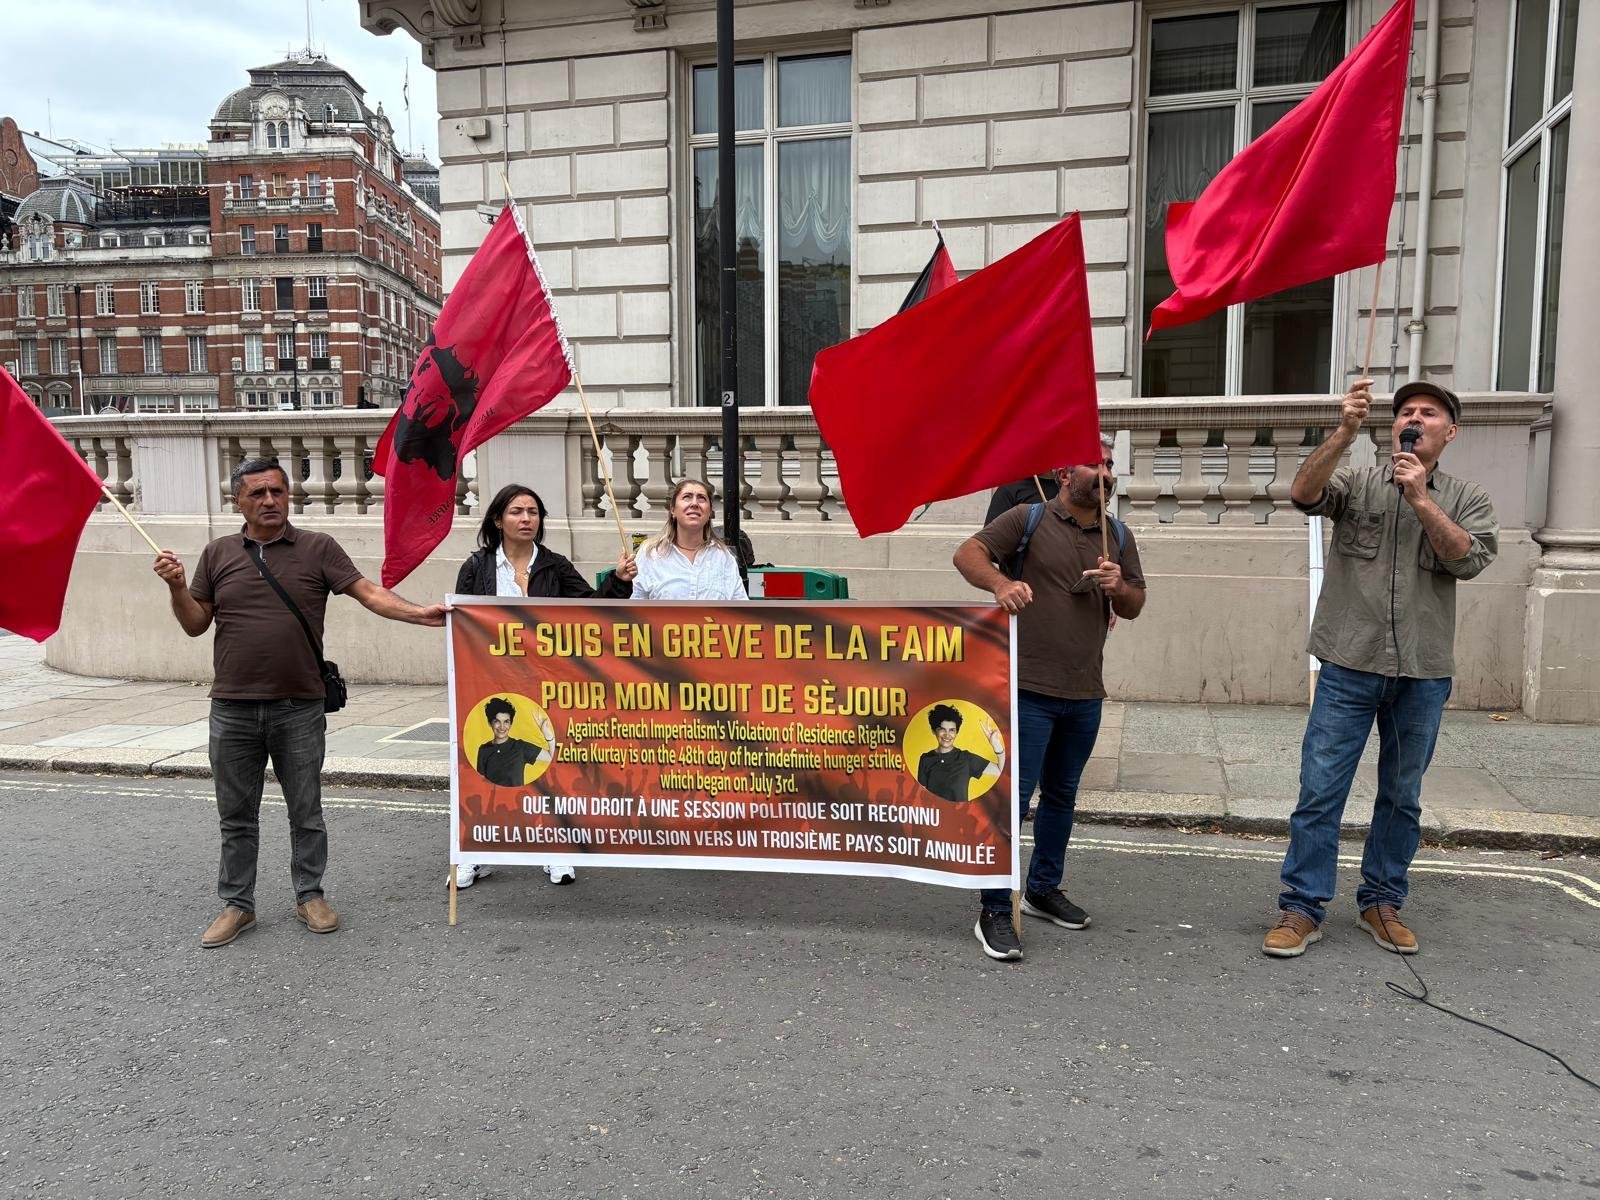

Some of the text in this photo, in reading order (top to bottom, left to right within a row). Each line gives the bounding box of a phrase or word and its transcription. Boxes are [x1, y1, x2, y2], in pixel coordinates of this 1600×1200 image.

[724, 393, 731, 405] 2
[489, 616, 964, 662] JE SUIS EN GRÈVE DE LA FAIM
[540, 679, 908, 717] POUR MON DROIT DE SÈJOUR
[566, 717, 896, 749] Against French Imperialism's Violation of Residence Rights
[556, 743, 906, 774] Zehra Kurtay is on the 48th day of her indefinite hunger strike,
[660, 770, 798, 798] which began on July 3rd.
[522, 793, 940, 827] QUE MON DROIT À UNE SESSION POLITIQUE SOIT RECONNU
[473, 824, 996, 865] QUE LA DÉCISION D'EXPULSION VERS UN TROISIÈME PAYS SOIT ANNULÉE
